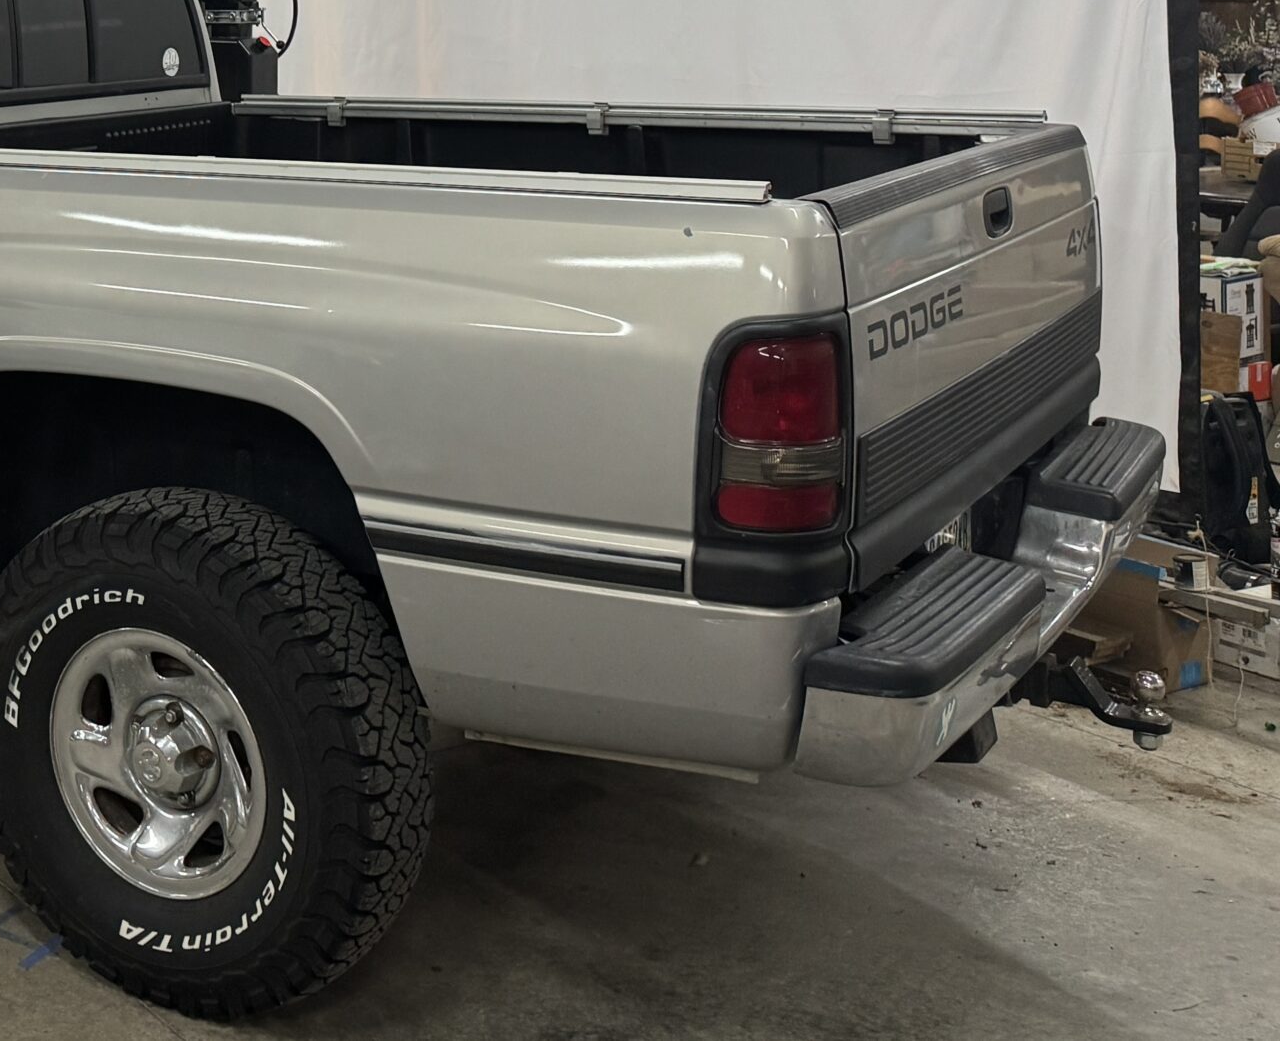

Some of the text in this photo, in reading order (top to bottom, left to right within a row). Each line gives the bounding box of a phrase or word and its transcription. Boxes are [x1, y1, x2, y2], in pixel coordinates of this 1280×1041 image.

[867, 284, 964, 360] DODGE
[4, 588, 145, 728] BFGoodrich
[118, 788, 296, 952] All-Terrain T/A
